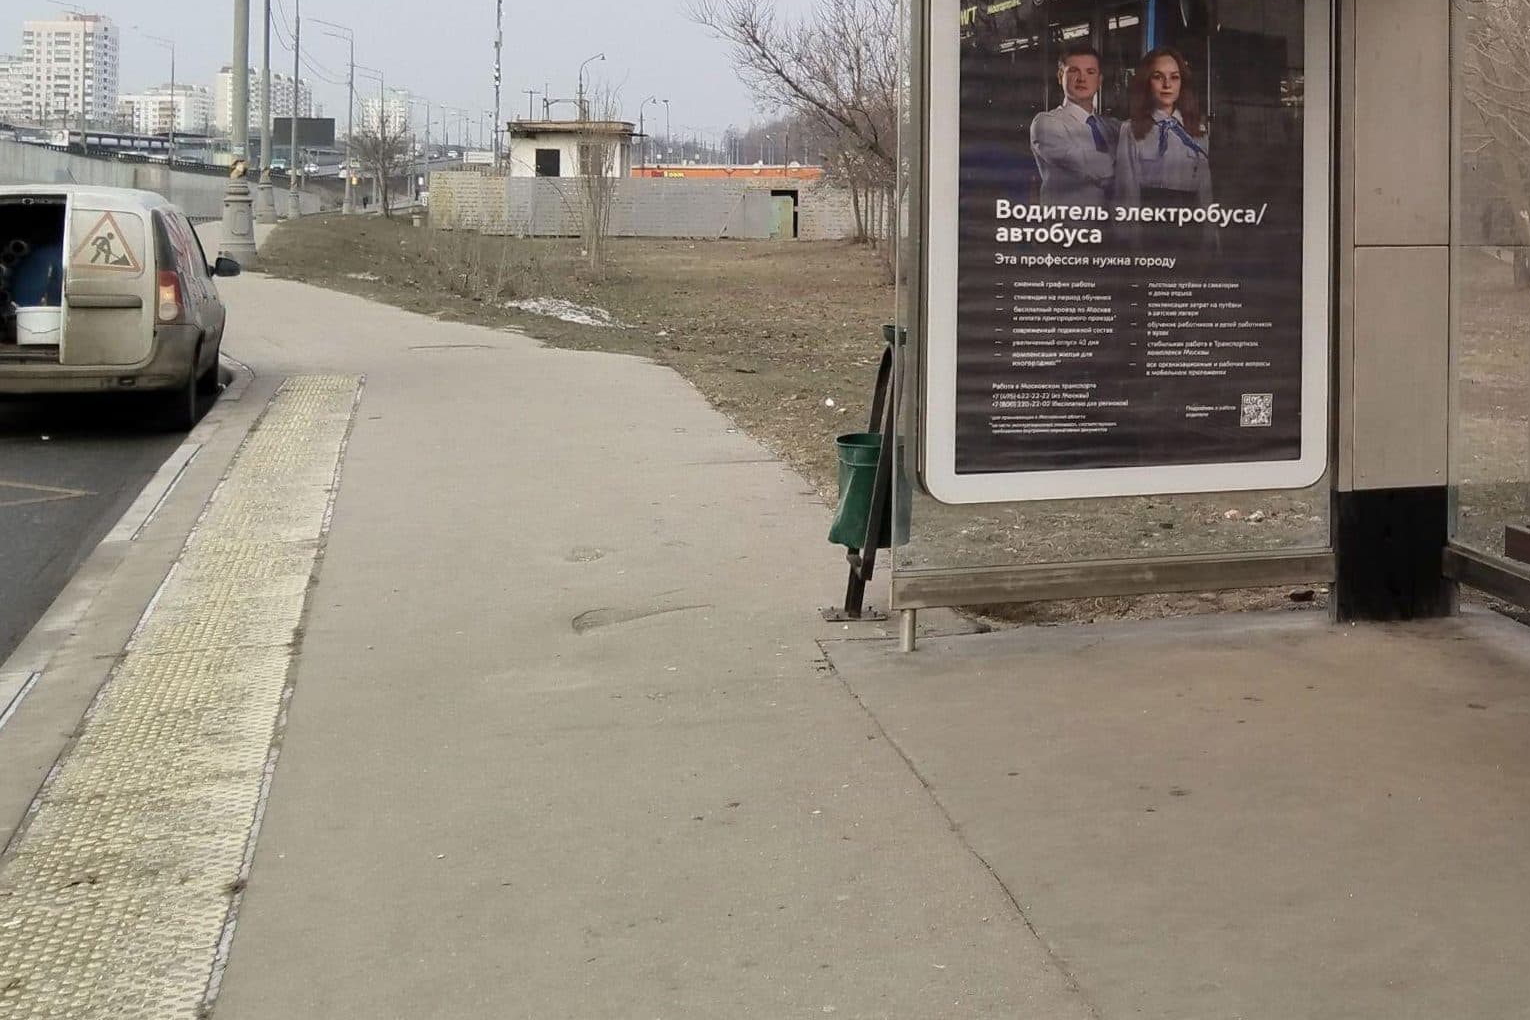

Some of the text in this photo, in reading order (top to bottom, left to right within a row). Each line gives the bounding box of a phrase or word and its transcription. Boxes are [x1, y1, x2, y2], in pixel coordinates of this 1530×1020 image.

[995, 199, 1268, 227] Водитель электробуса/
[995, 223, 1102, 247] автобуса
[995, 253, 1176, 269] Эта профессия нужна городу
